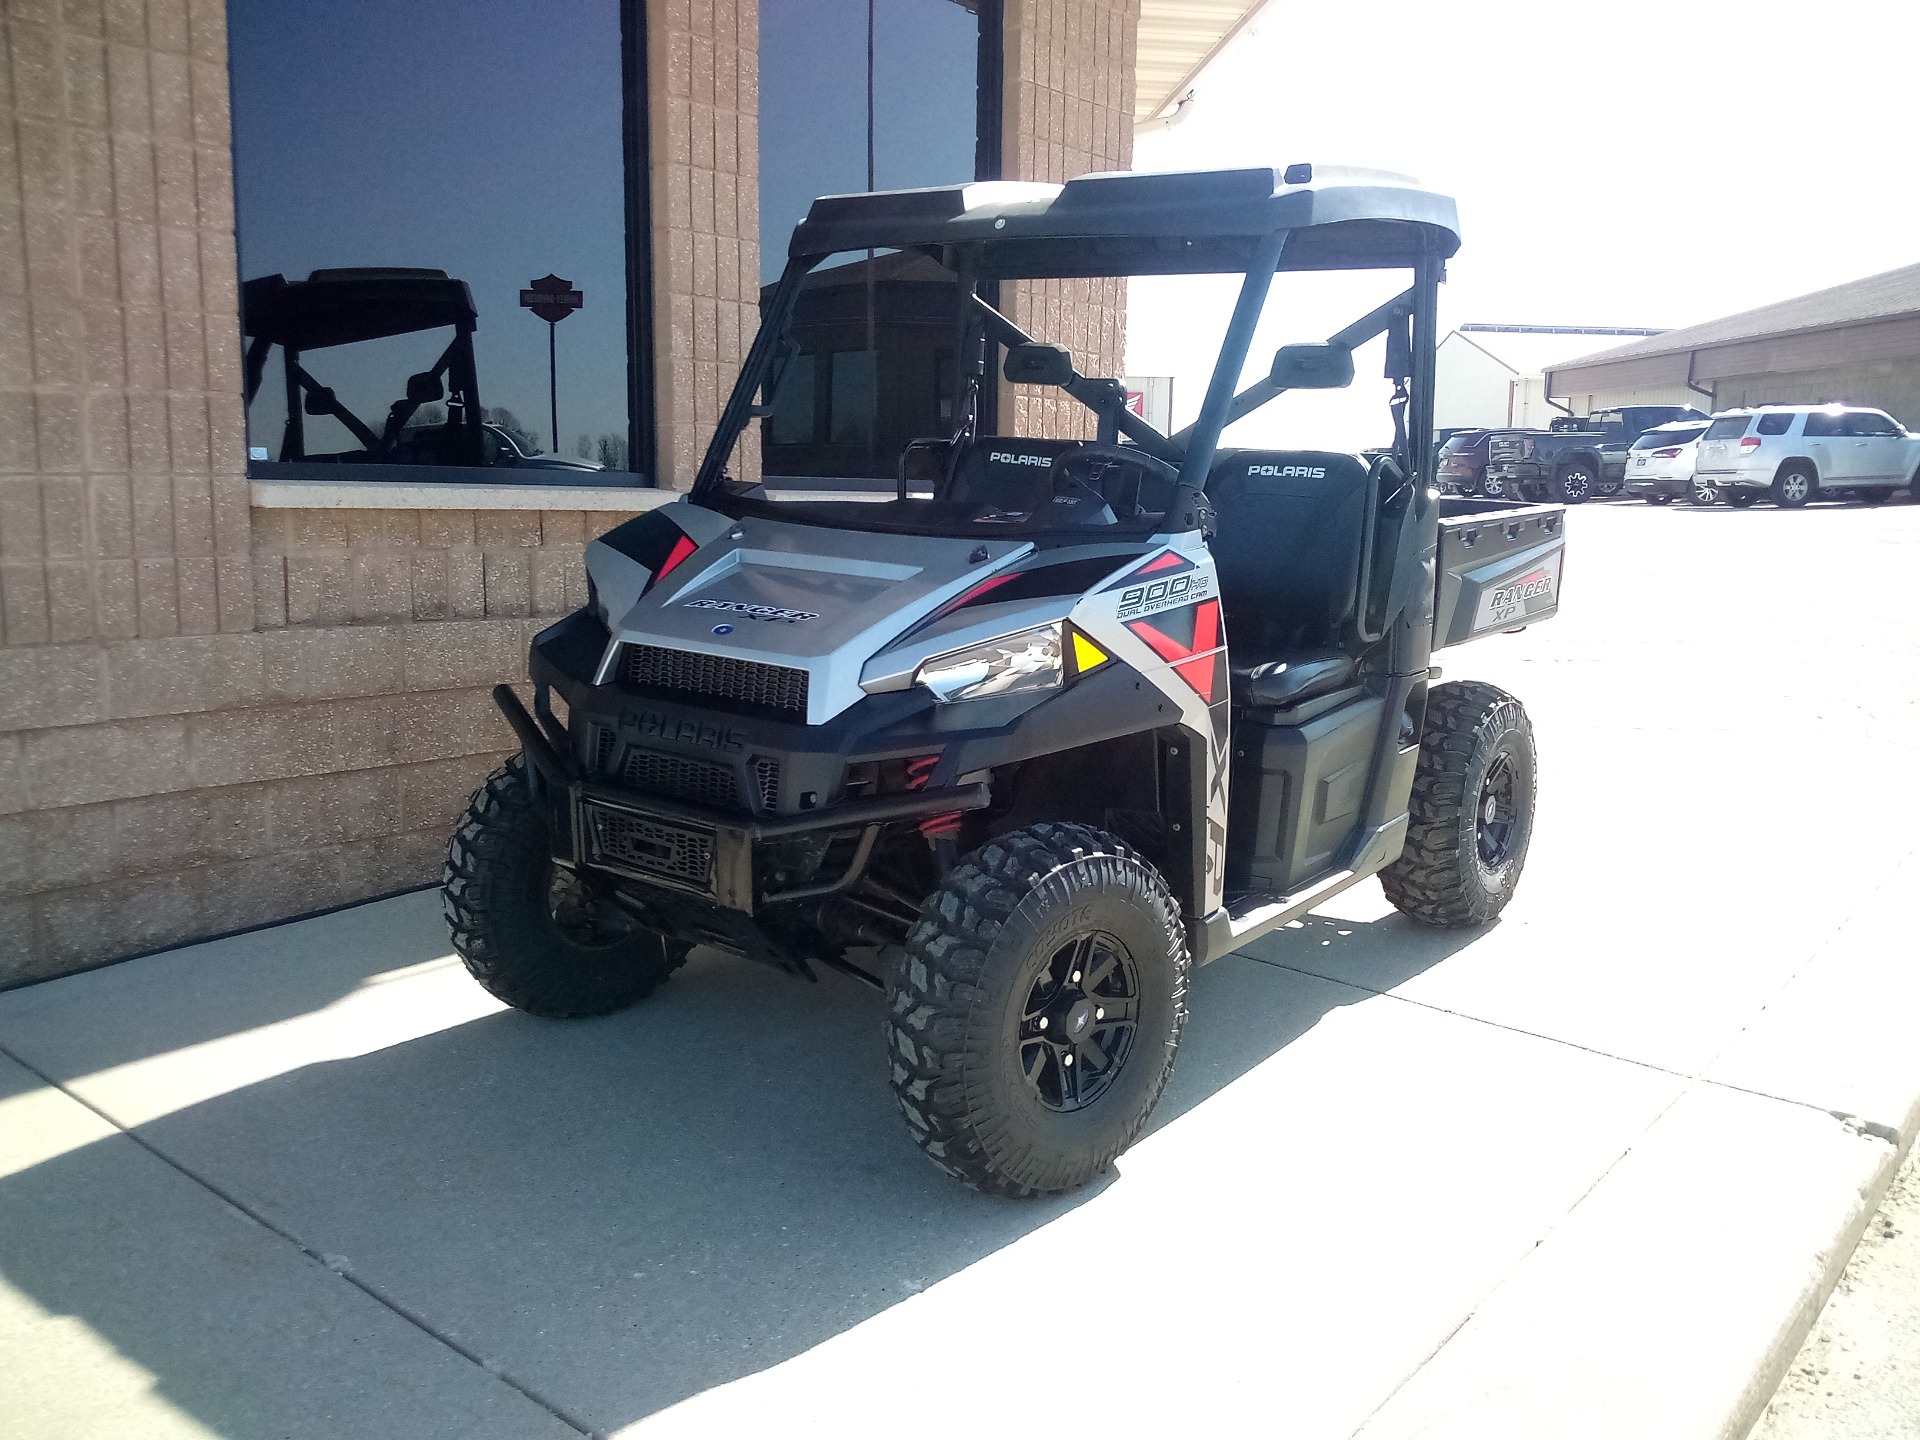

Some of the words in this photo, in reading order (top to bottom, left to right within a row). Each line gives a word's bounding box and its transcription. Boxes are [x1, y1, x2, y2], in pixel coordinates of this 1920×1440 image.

[989, 452, 1053, 468] POLARIS
[1247, 465, 1327, 479] POLARIS
[1117, 574, 1193, 612] 900
[1117, 609, 1141, 619] DUAL
[1144, 595, 1189, 612] OVERHEAD
[1190, 590, 1208, 600] CAM
[1489, 576, 1552, 610] RANGER
[1491, 606, 1516, 623] XP
[619, 709, 747, 754] POLARIS
